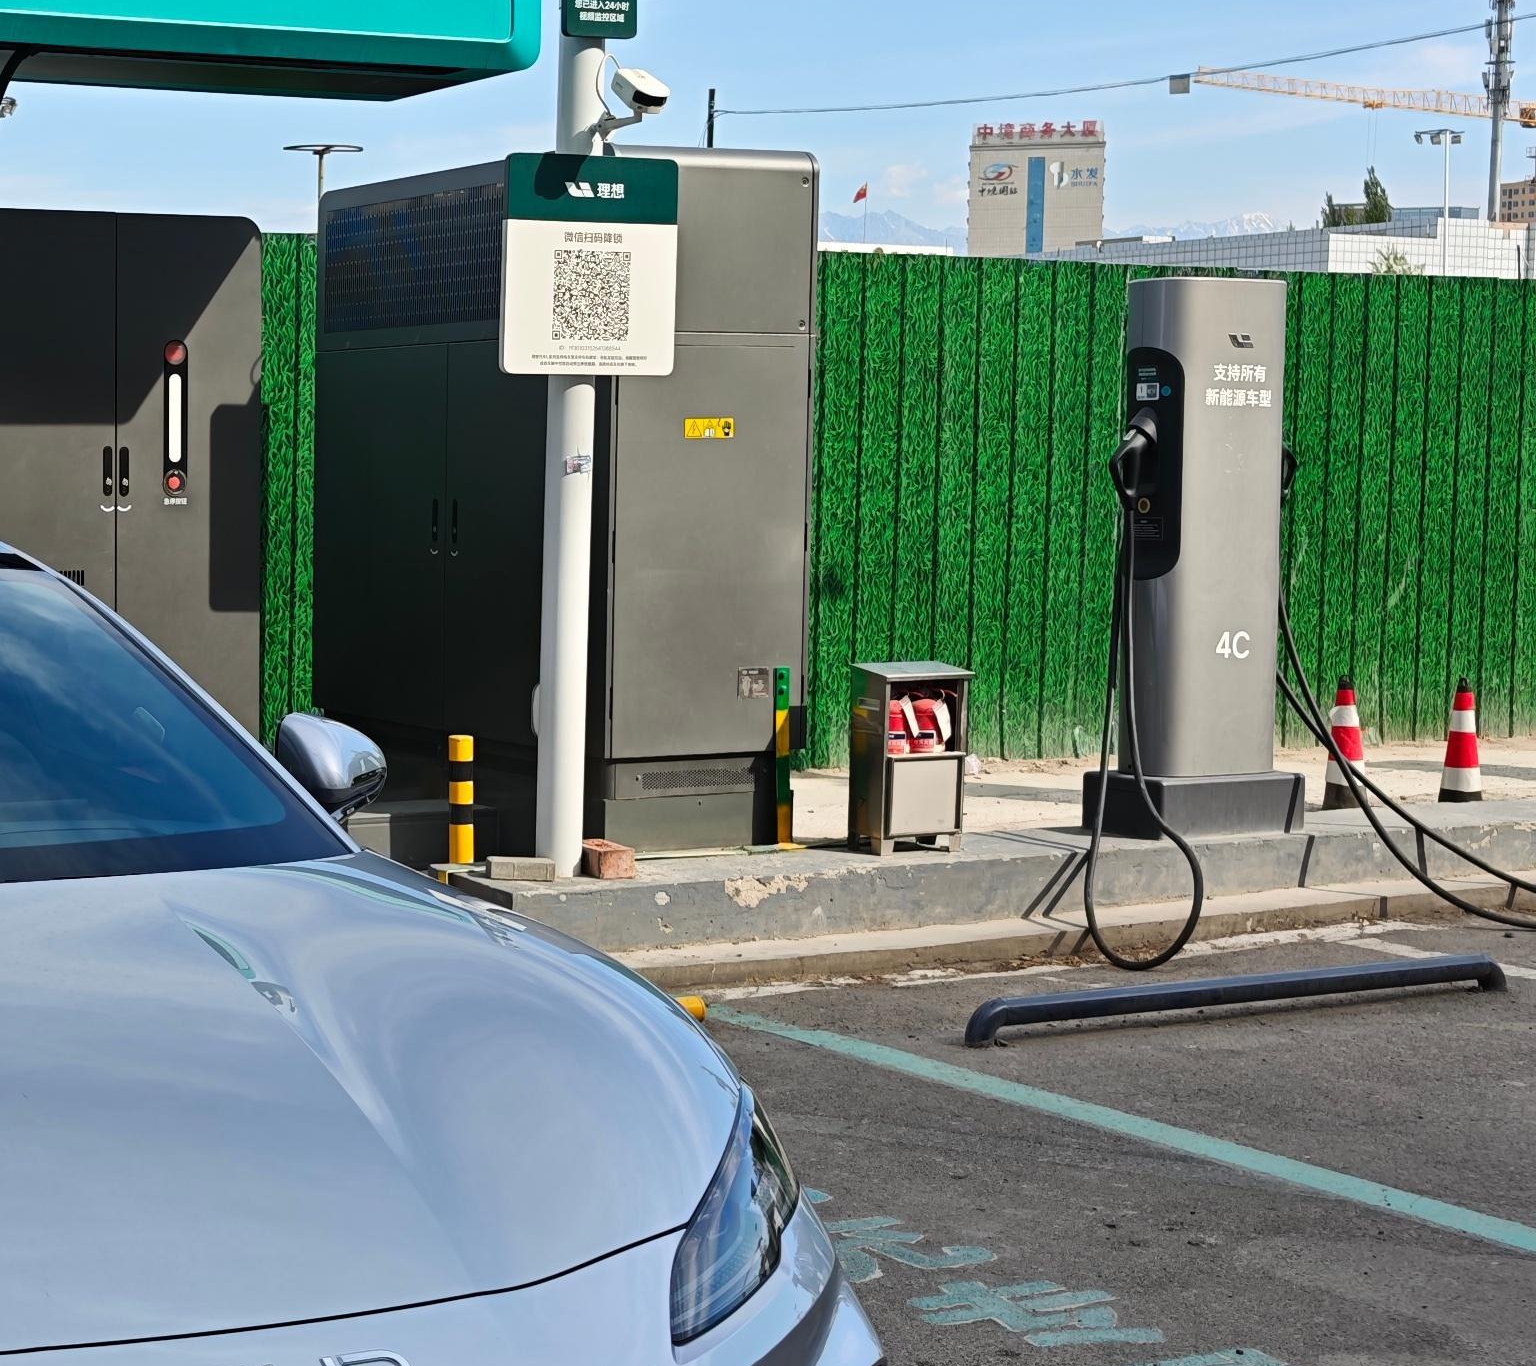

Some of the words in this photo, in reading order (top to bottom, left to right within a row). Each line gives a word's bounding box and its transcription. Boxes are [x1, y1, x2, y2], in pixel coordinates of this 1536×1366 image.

[574, 0, 630, 11] 您已进入24小时
[596, 183, 625, 199] 理想
[564, 231, 623, 244] 微信扫码降锁
[1213, 362, 1267, 383] 支持所有
[1205, 387, 1272, 408] 新能源车型
[1215, 630, 1251, 660] 4C
